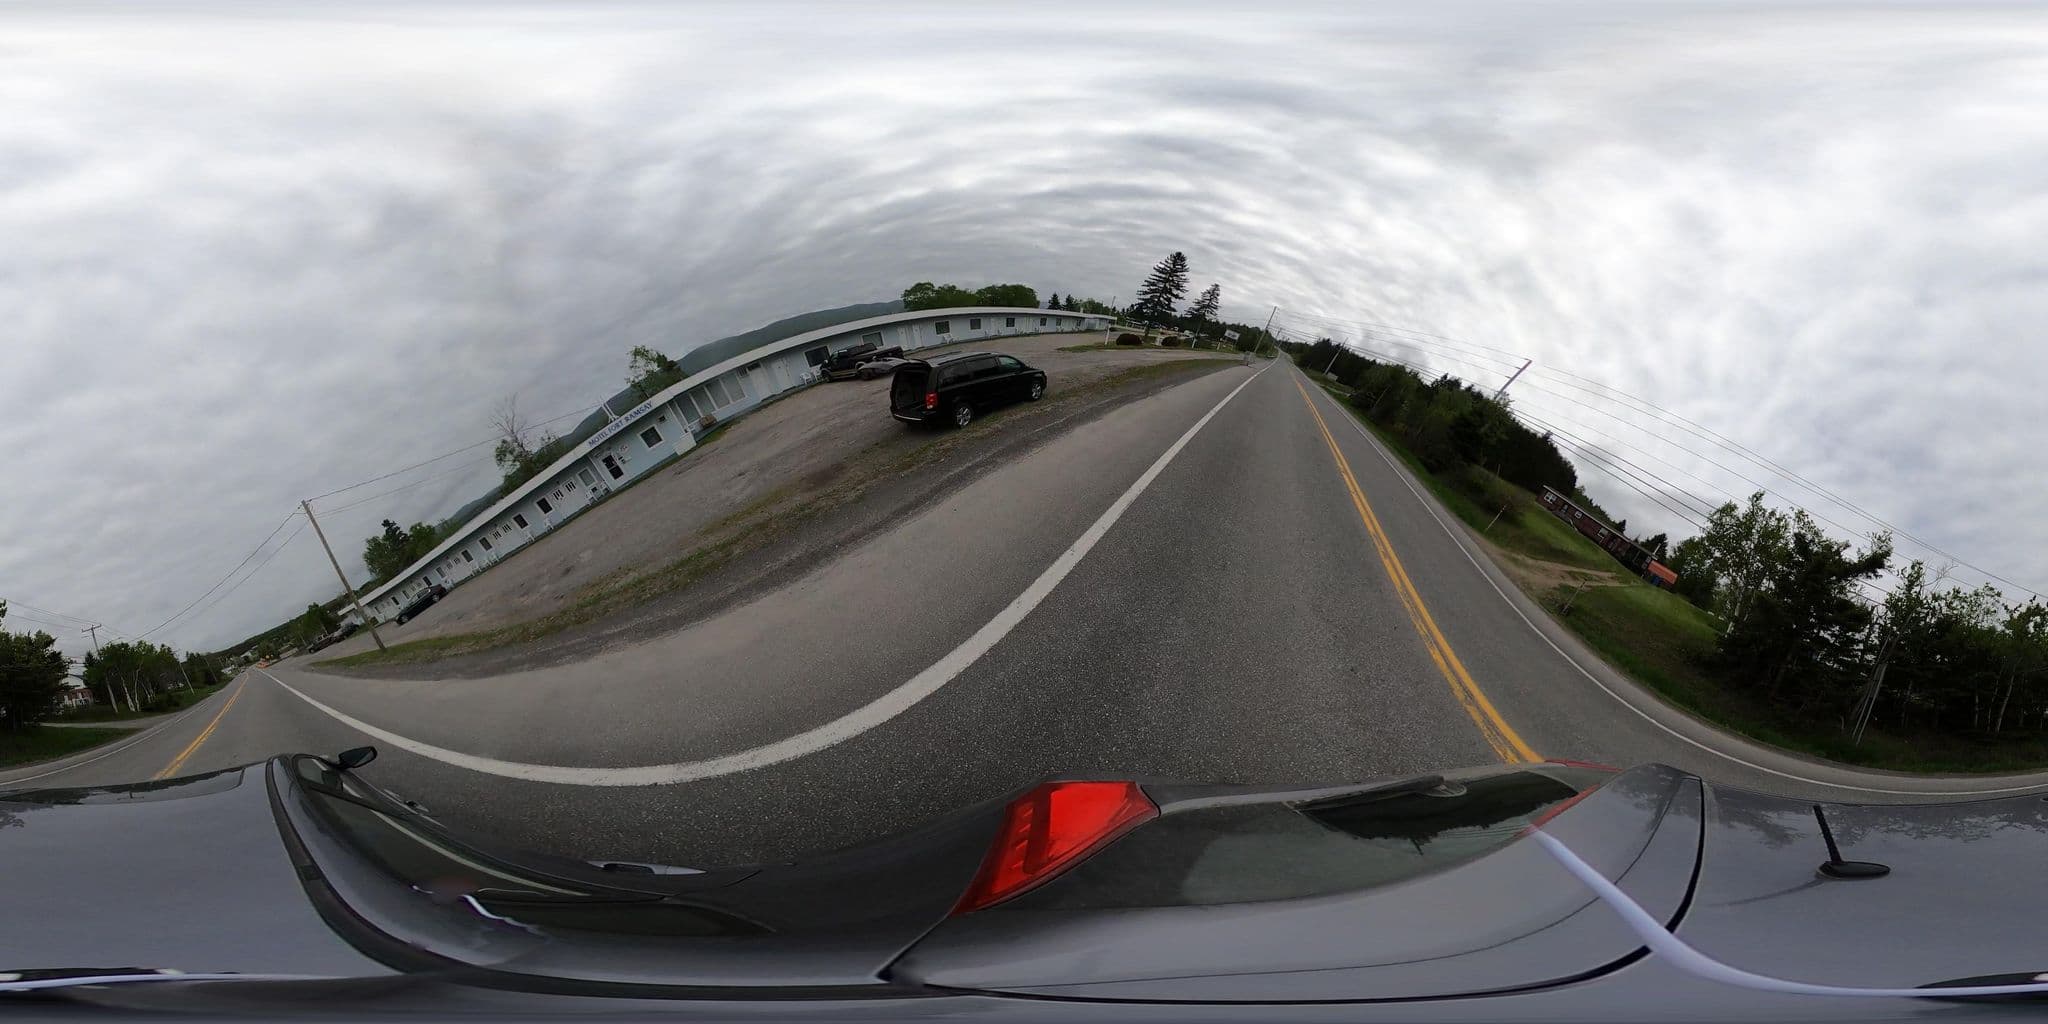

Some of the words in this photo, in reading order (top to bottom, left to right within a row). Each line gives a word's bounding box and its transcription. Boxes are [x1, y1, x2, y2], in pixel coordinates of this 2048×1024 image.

[588, 431, 608, 447] MOTEL
[608, 420, 624, 434] FORT
[624, 400, 652, 422] RAMSAY
